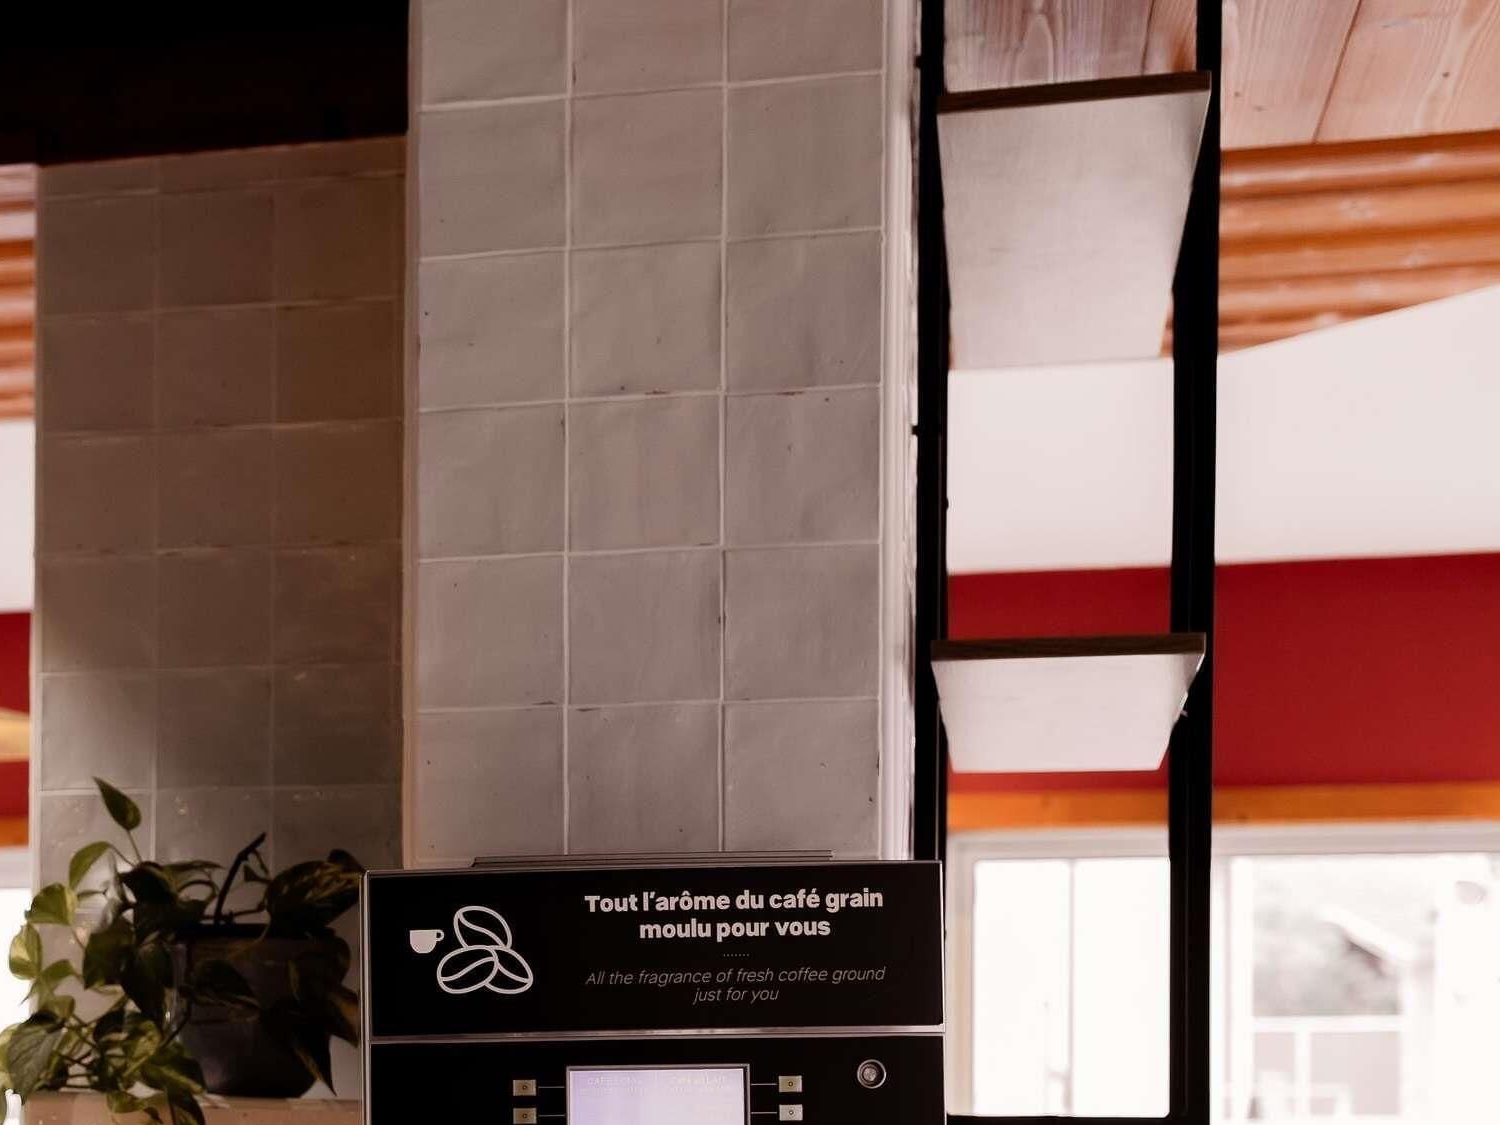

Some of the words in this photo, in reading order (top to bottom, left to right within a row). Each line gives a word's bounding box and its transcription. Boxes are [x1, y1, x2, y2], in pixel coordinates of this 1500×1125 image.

[584, 893, 639, 913] Tout
[642, 890, 731, 912] l'arôme
[735, 889, 765, 910] du
[768, 887, 821, 909] café
[825, 887, 884, 914] grain
[639, 917, 712, 939] moulu
[716, 920, 770, 943] pour
[774, 919, 831, 937] vous
[585, 971, 605, 985] All
[608, 970, 634, 985] the
[638, 969, 712, 987] fragrance
[715, 967, 734, 983] of
[735, 967, 774, 983] fresh
[778, 966, 829, 982] coffee
[831, 965, 887, 985] ground
[692, 987, 722, 1004] just
[726, 986, 749, 1001] for
[750, 989, 780, 1005] you
